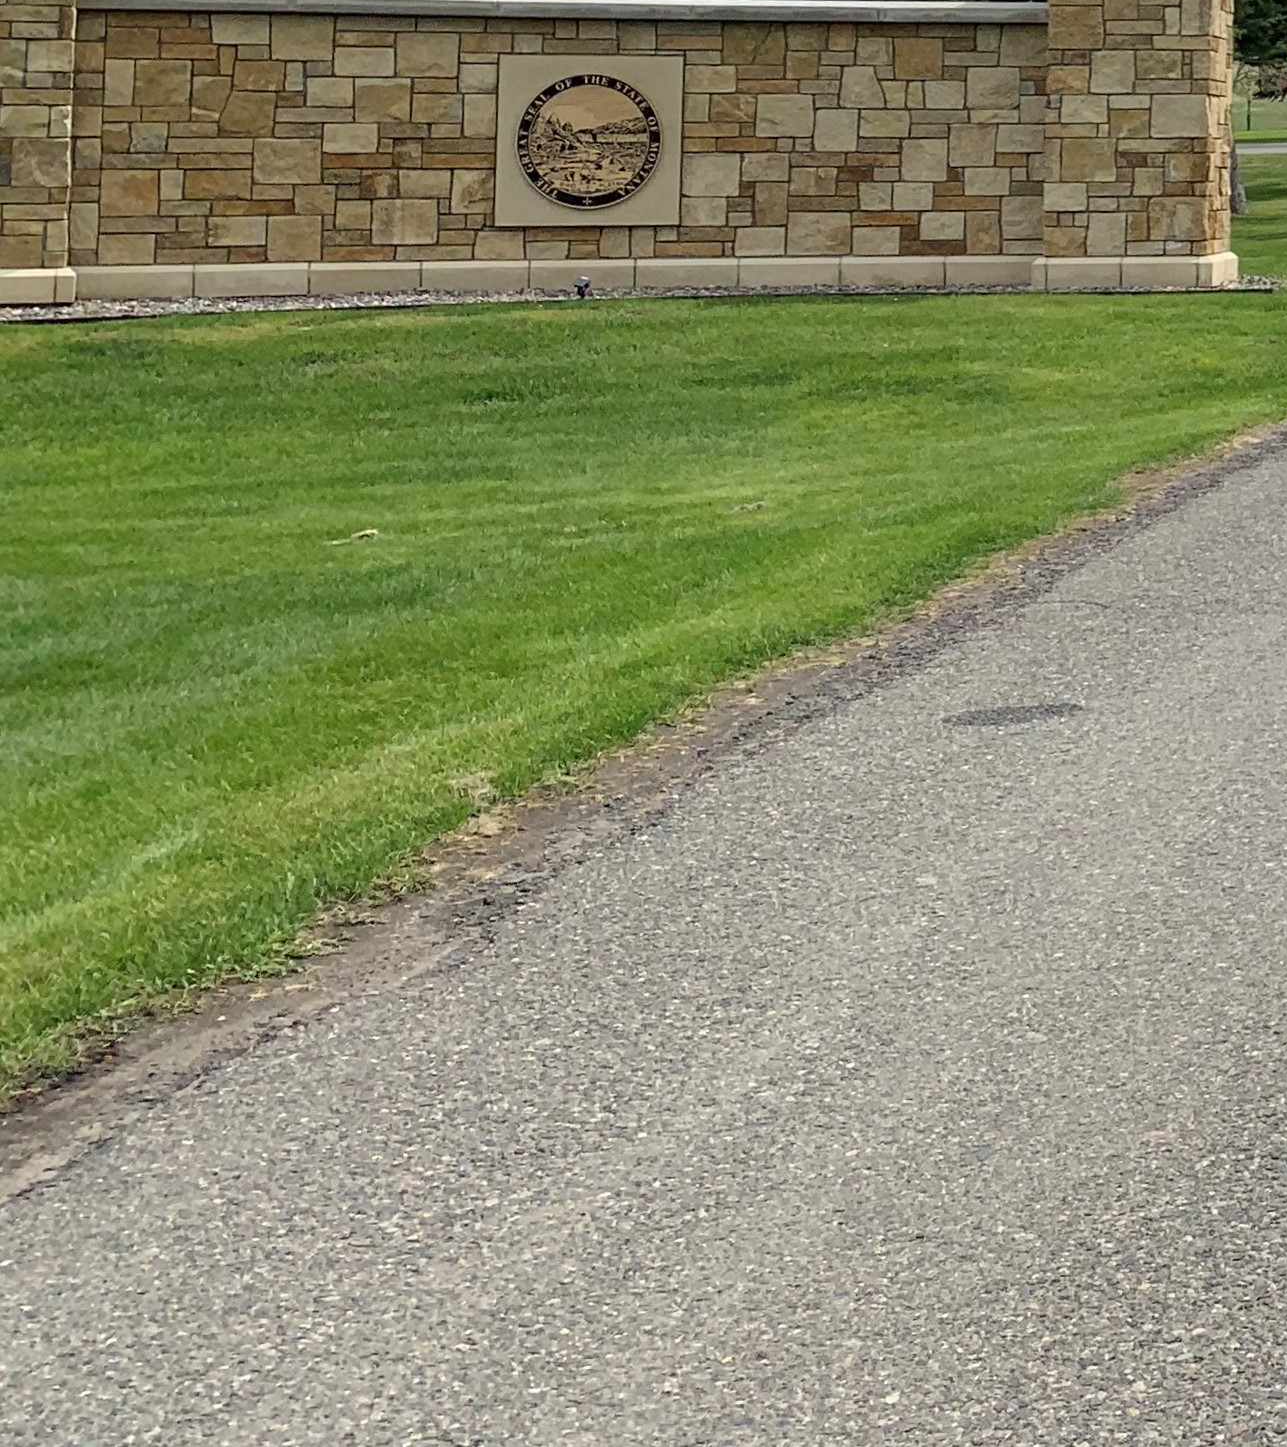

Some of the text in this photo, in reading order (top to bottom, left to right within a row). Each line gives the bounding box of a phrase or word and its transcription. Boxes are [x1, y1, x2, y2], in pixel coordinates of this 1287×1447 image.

[518, 75, 659, 199] THE GREAT SEAL OF THE STATE OF MONTANA
